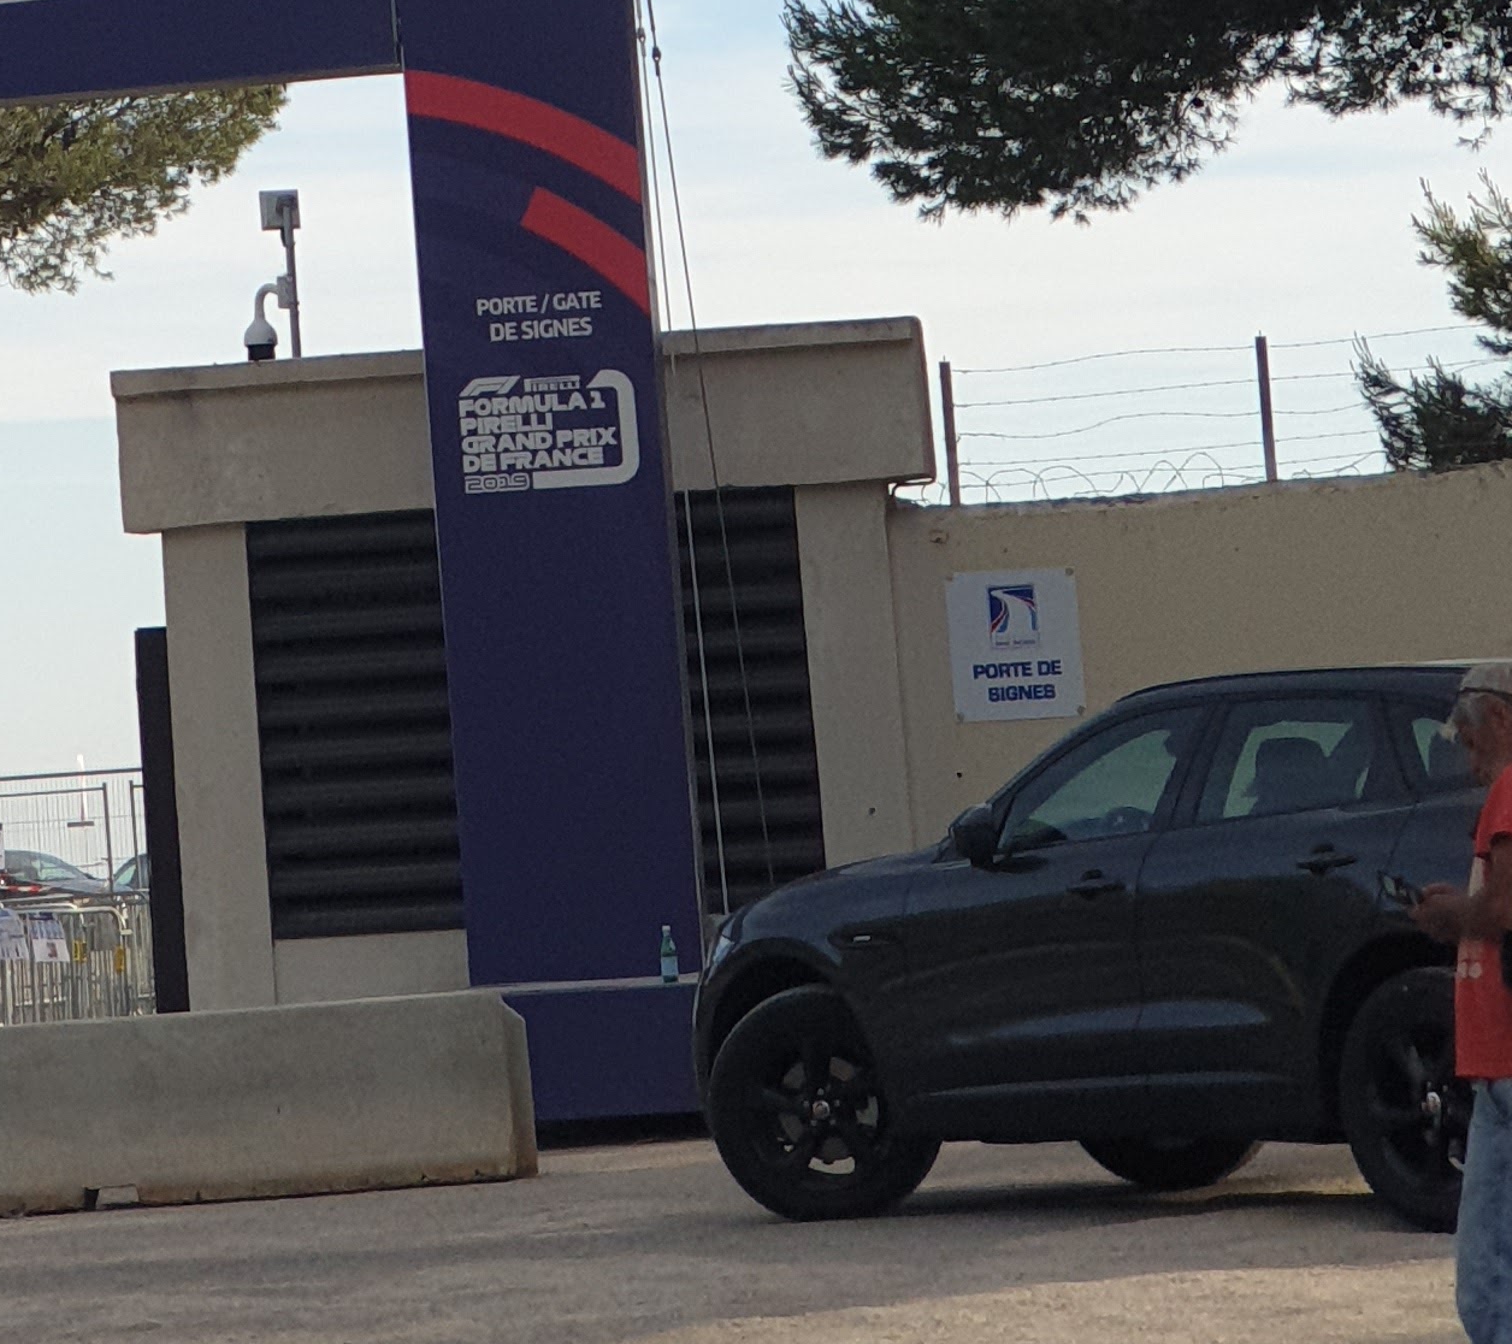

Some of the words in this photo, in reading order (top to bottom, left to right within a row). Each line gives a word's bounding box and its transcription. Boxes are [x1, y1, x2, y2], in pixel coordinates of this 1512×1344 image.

[476, 295, 538, 316] PORTE
[552, 291, 603, 311] GATE
[489, 322, 518, 342] DE
[521, 317, 593, 340] SIGNES
[524, 375, 581, 393] PIRELLI
[458, 392, 587, 417] FORMULA
[591, 391, 606, 409] 1
[460, 413, 553, 436] PIRELLI
[461, 431, 553, 455] GRAND
[556, 427, 618, 449] PRIX
[462, 453, 497, 474] DE
[500, 447, 605, 472] FRANCE
[465, 473, 531, 494] 2019
[973, 661, 1033, 680] PORTE
[1038, 659, 1063, 676] DE
[988, 683, 1056, 703] SIGNES
